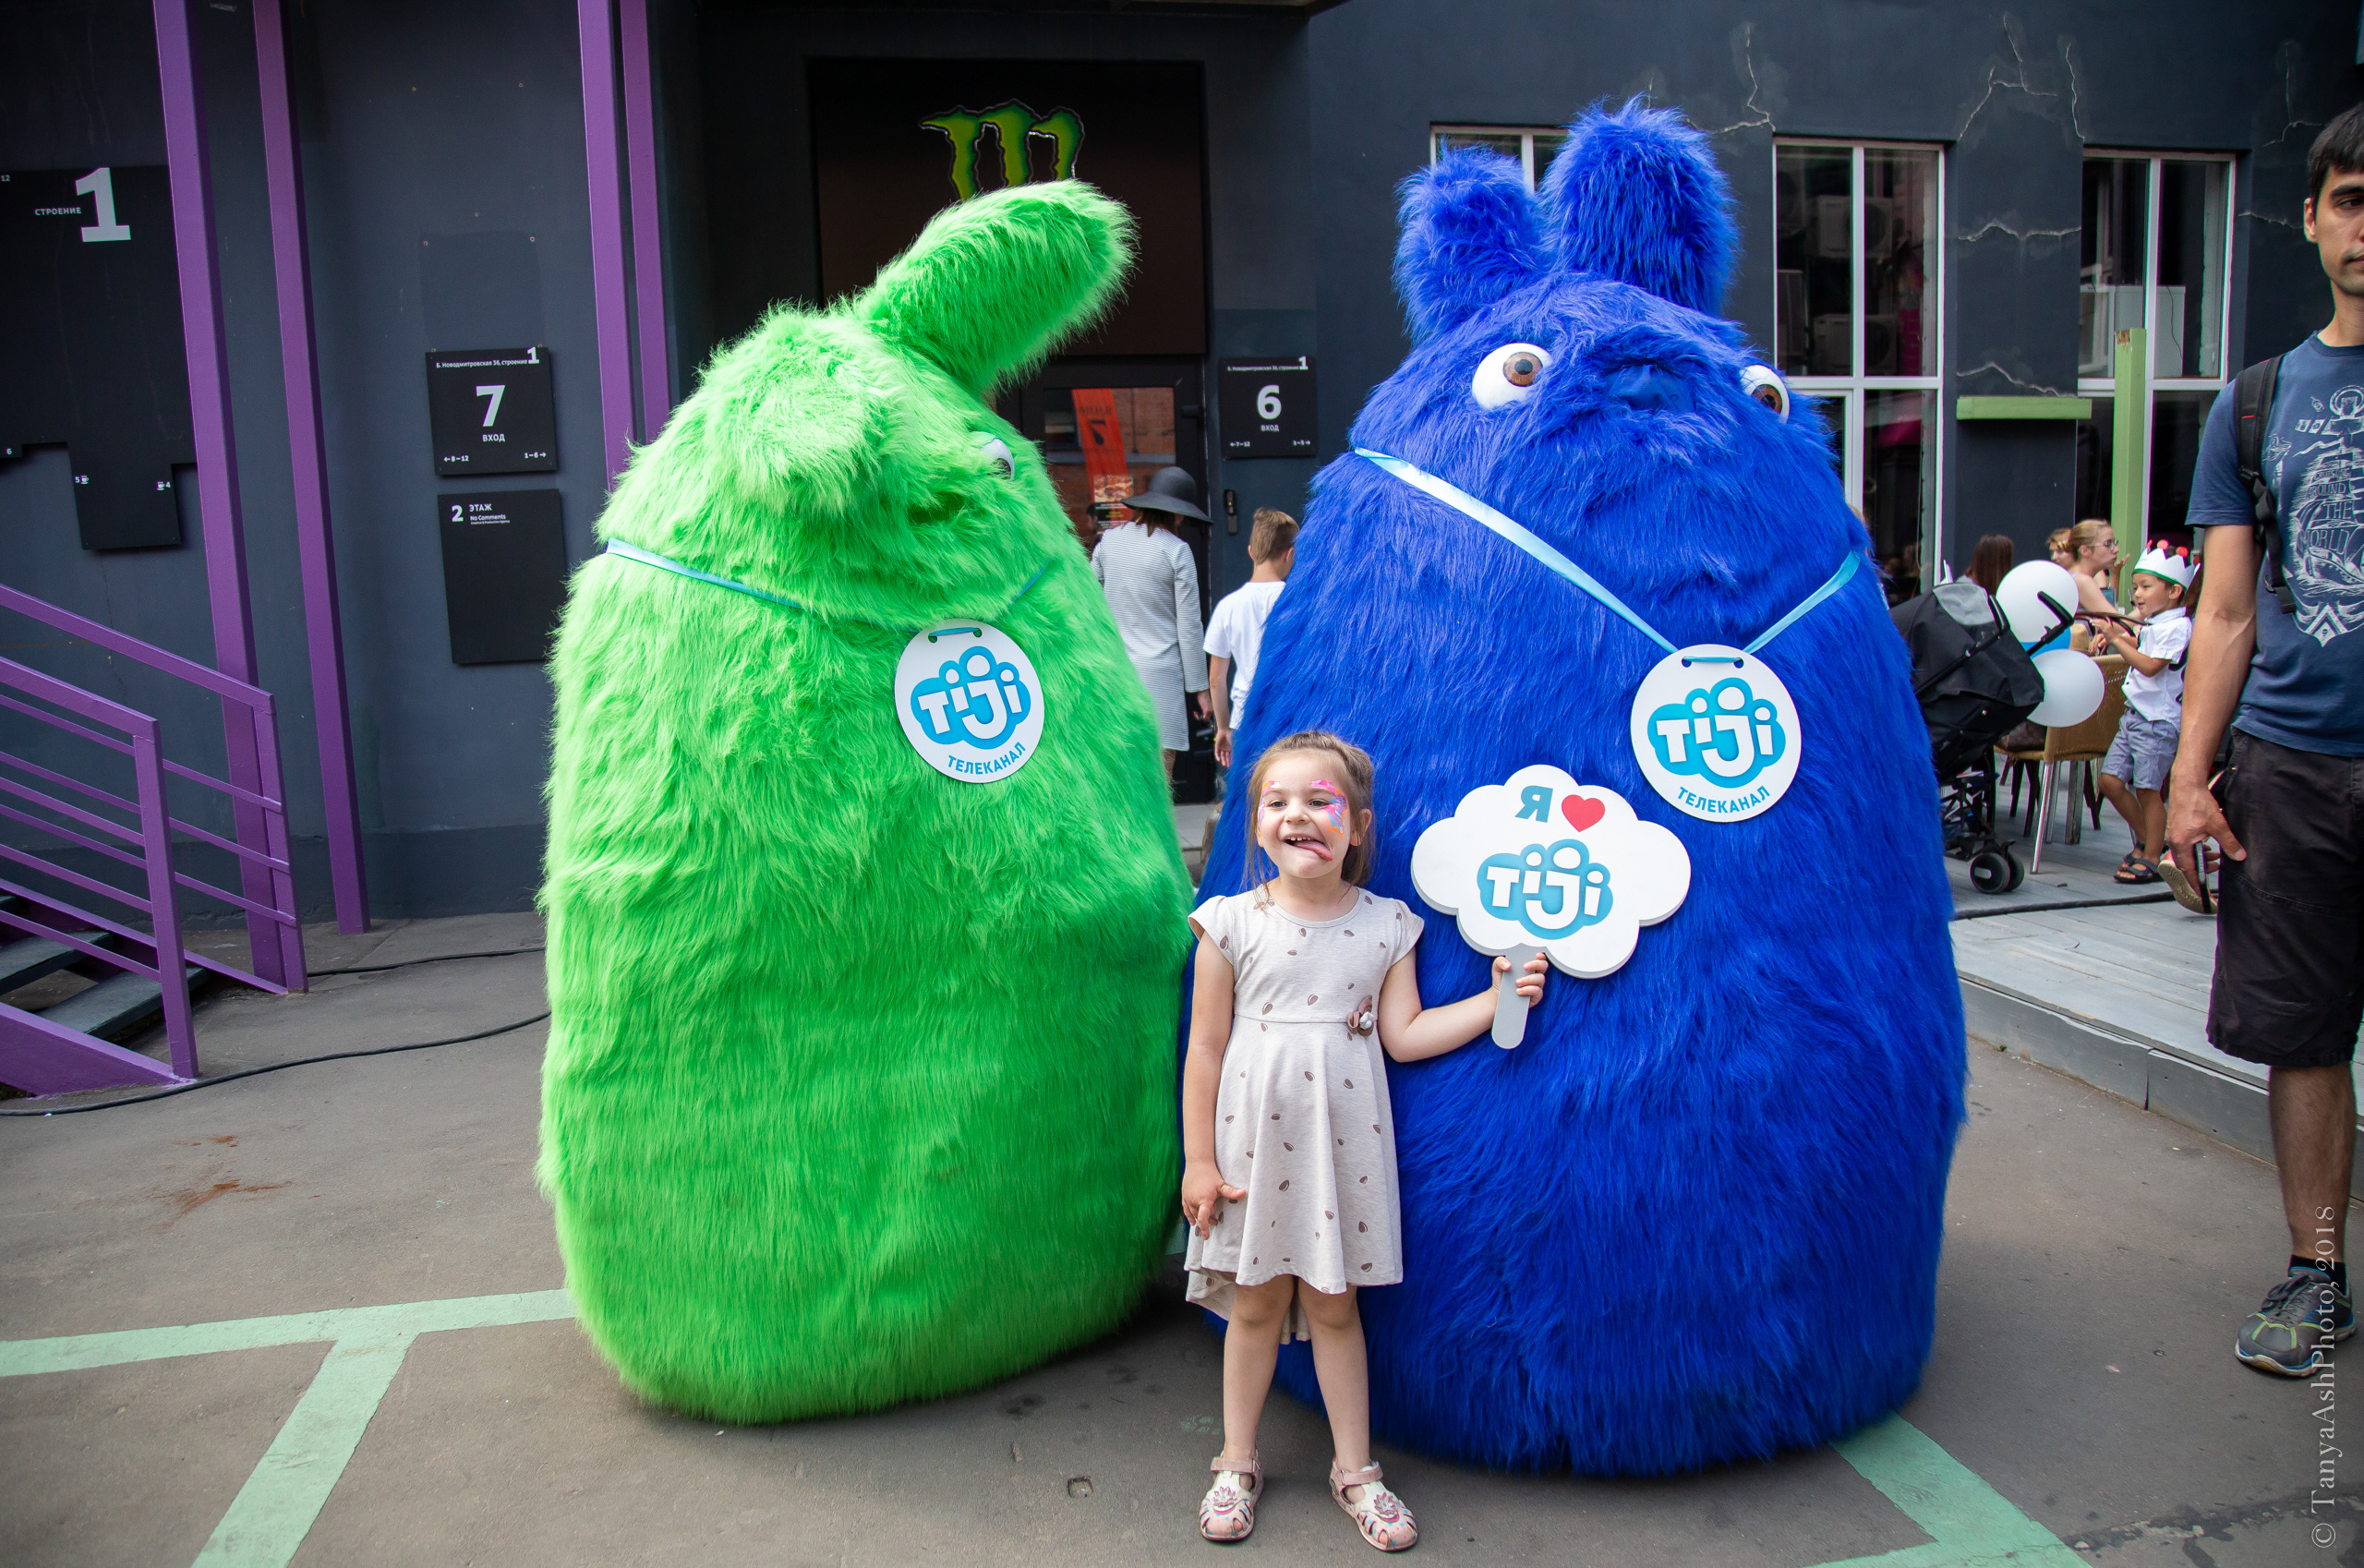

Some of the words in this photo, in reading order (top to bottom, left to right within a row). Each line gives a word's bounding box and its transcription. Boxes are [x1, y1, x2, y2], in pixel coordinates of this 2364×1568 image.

[34, 207, 82, 216] СТРОЕНИЕ
[75, 166, 131, 243] 1
[442, 360, 492, 368] Новодмитровская
[527, 346, 539, 364] 1
[1298, 356, 1309, 370] 1
[476, 384, 505, 427] 7
[1257, 384, 1282, 420] 6
[482, 433, 505, 442] ВХОД
[452, 505, 464, 522] 2
[469, 503, 492, 512] ЭТАЖ
[2322, 501, 2353, 519] THE
[947, 742, 1026, 775] ТЕЛЕКАНАЛ
[1514, 785, 1553, 823] Я
[1677, 786, 1770, 814] ТЕЛЕКАНАЛ
